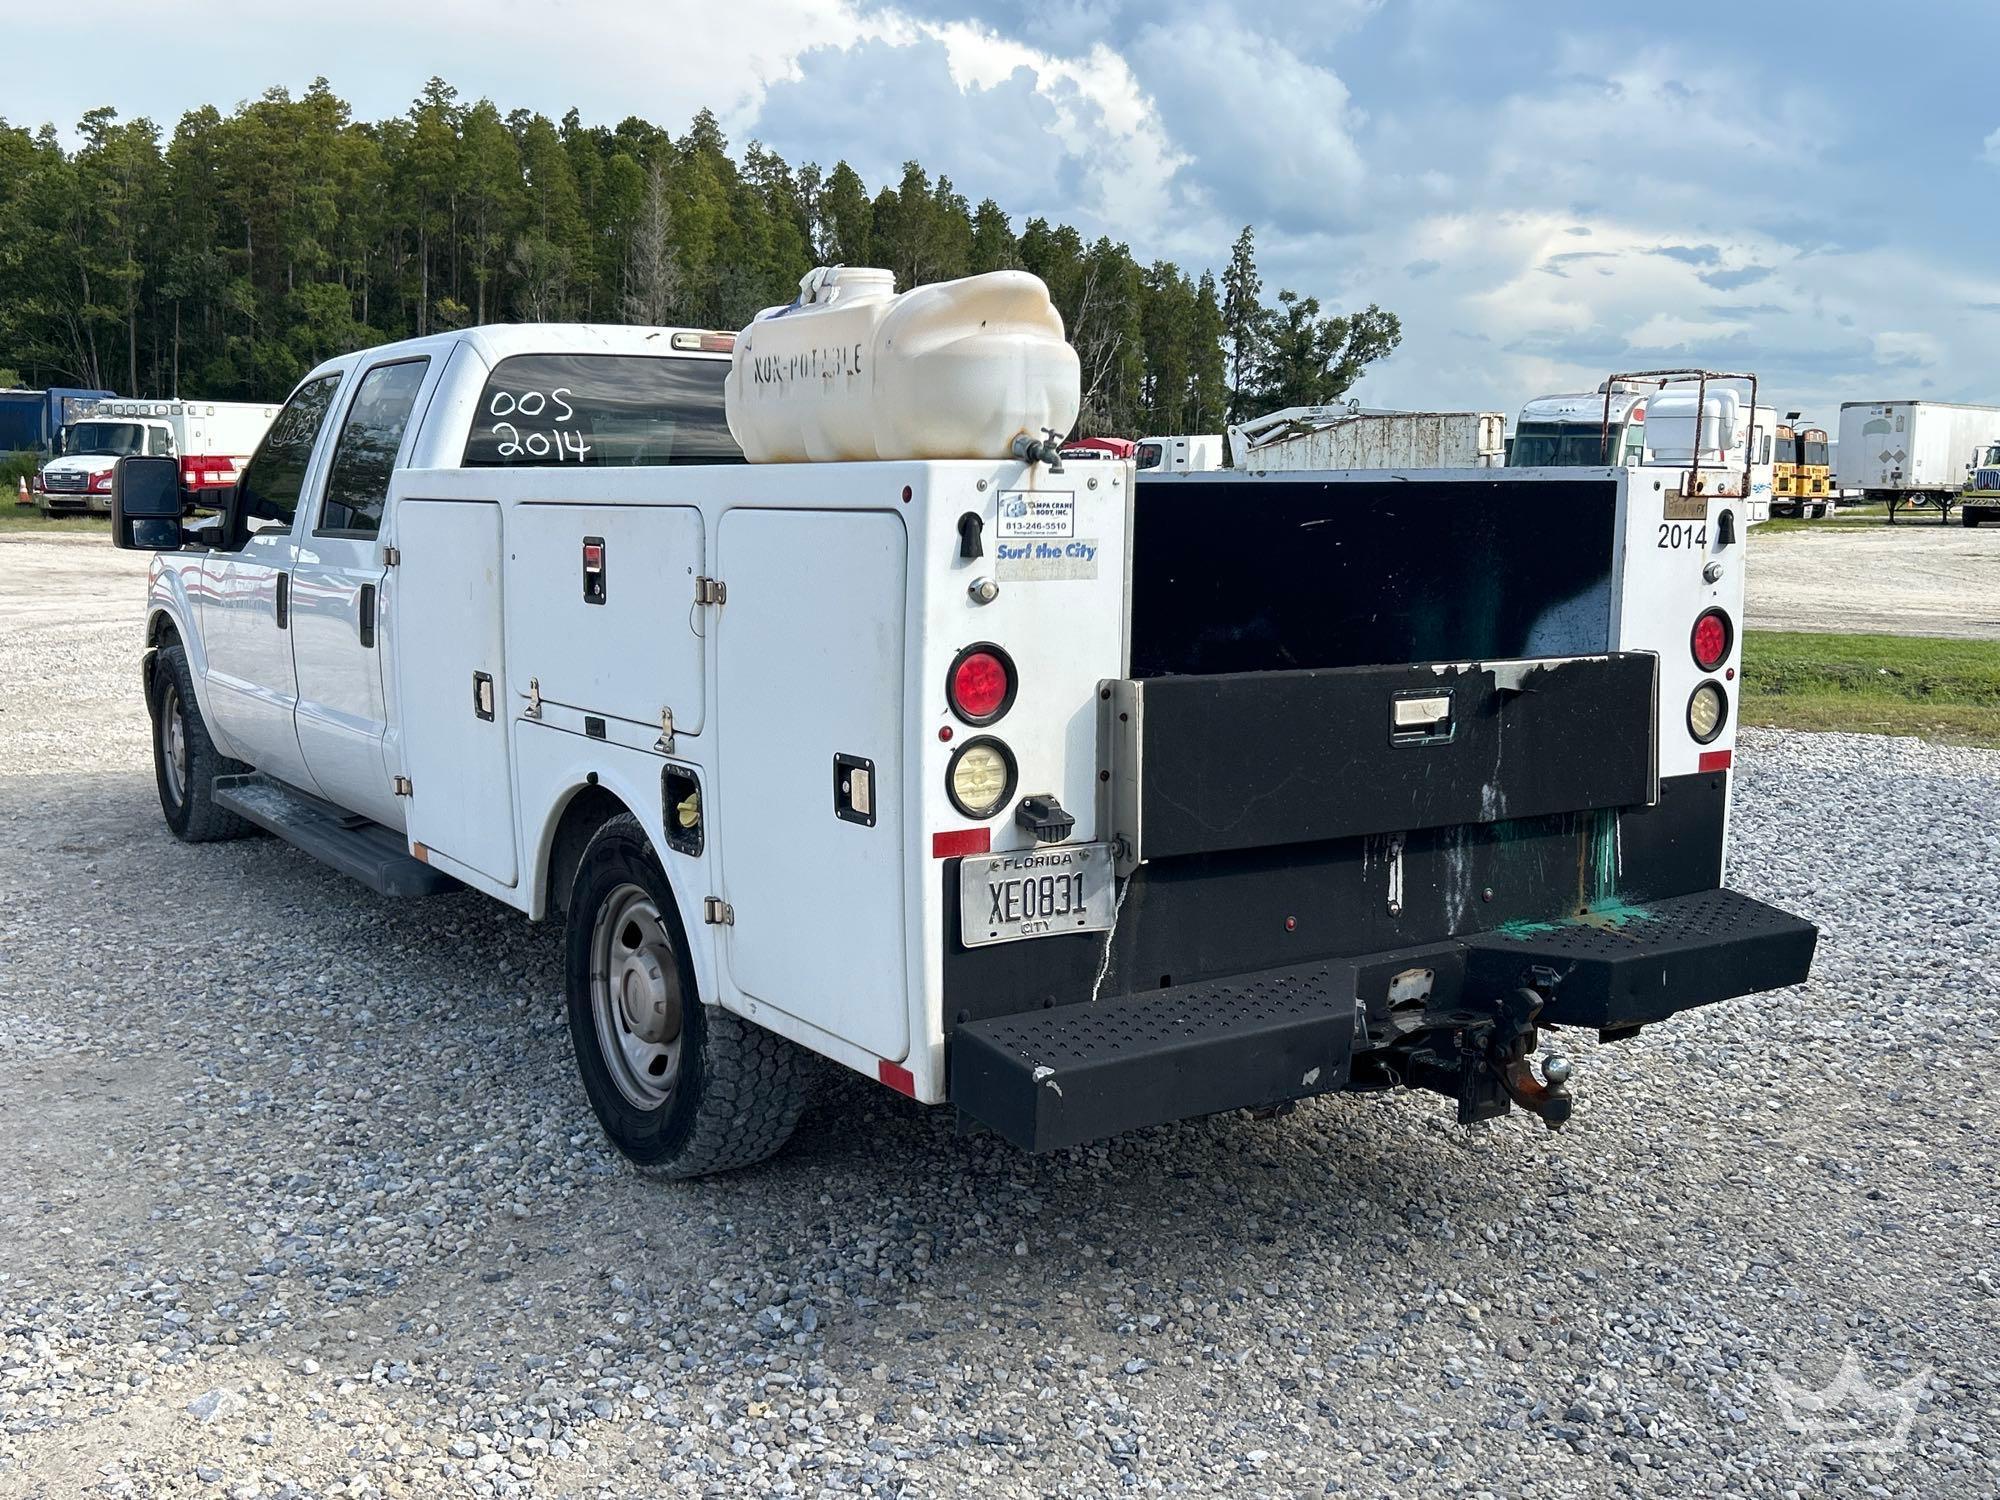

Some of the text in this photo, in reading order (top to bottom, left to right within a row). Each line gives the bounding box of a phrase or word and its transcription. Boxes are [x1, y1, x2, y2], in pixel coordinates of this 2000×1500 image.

[491, 421, 591, 462] 2014
[1006, 522, 1067, 530] 813-246-5510
[1657, 523, 1707, 550] 2014
[997, 542, 1097, 561] Surf the City
[1003, 853, 1073, 871] FLORIDA
[988, 871, 1087, 925] XE0831
[1021, 920, 1051, 935] CITY
